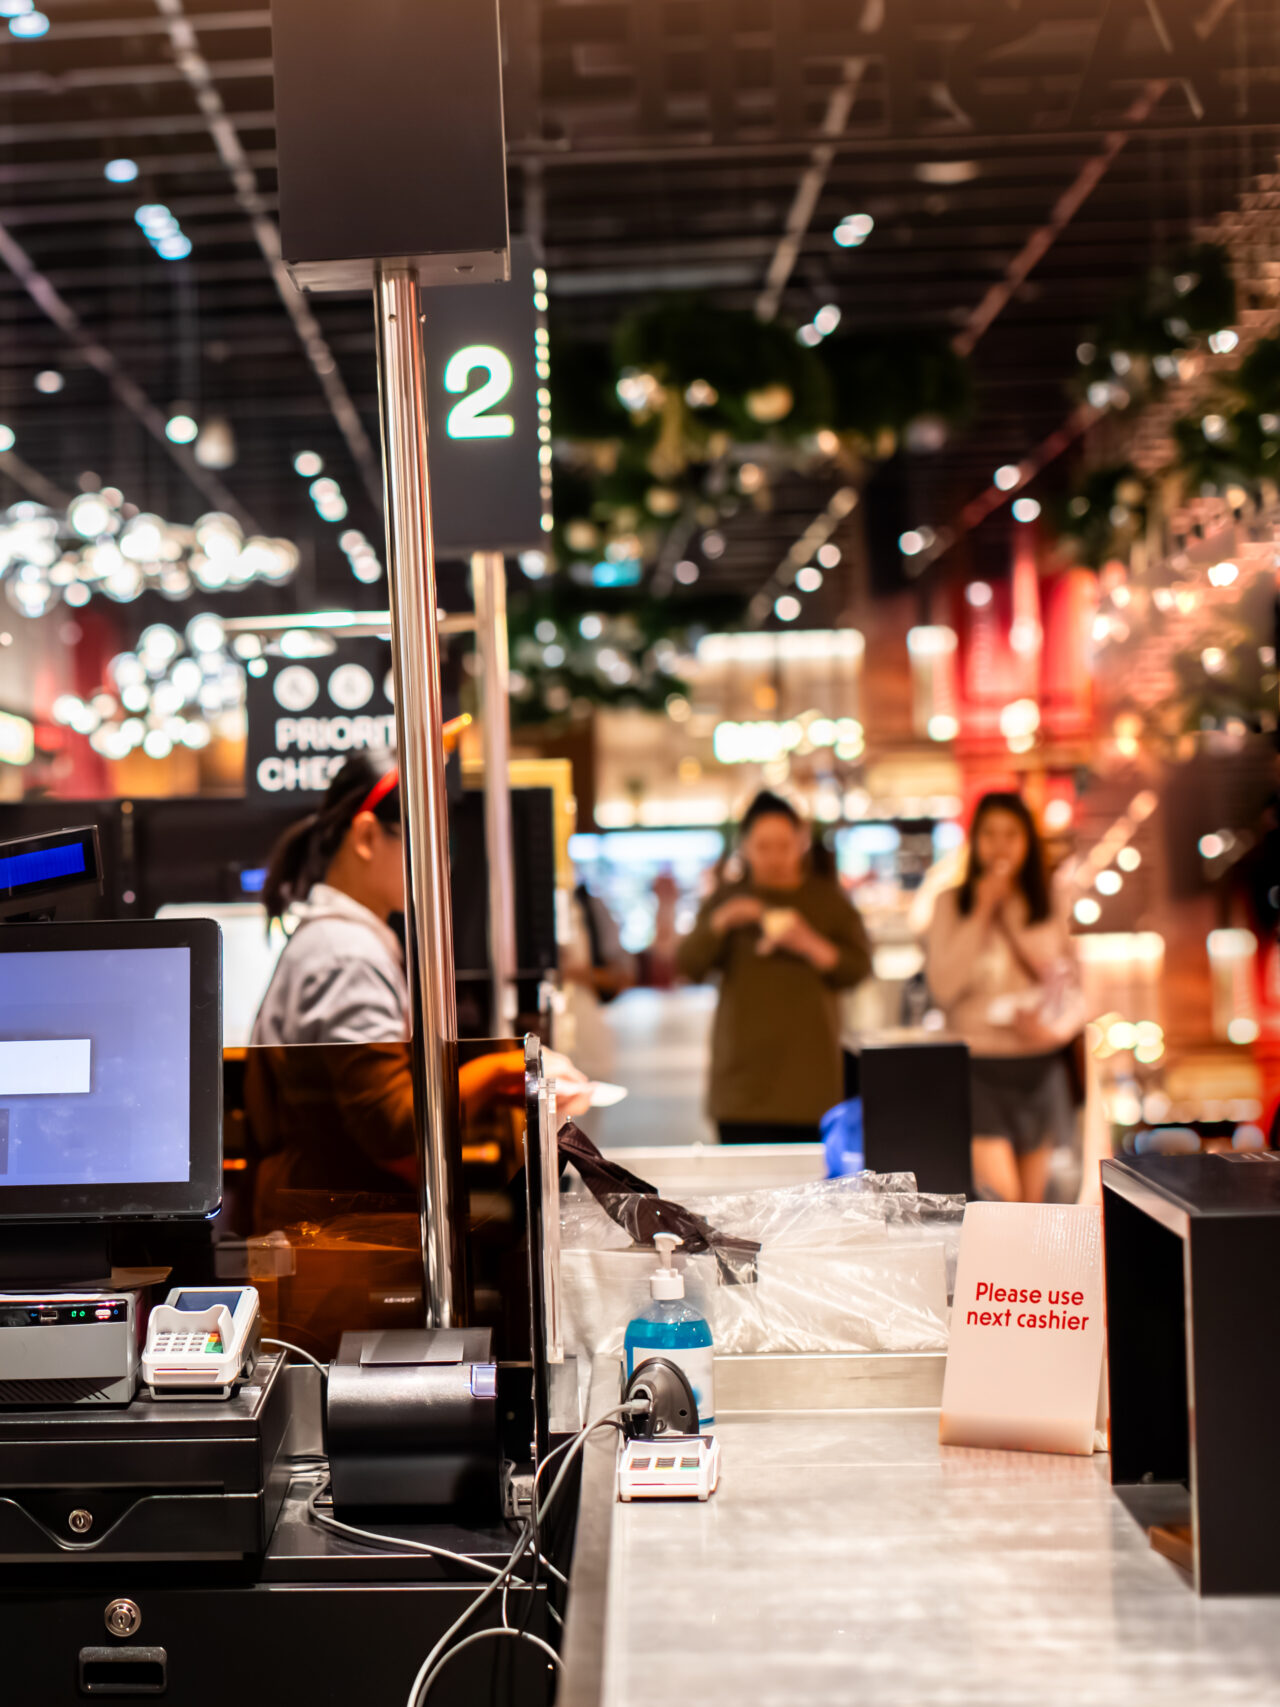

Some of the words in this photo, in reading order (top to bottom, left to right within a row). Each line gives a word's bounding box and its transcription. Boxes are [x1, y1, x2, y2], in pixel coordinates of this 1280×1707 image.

[443, 344, 515, 439] 2
[274, 715, 397, 752] PRIORIT
[975, 1281, 1042, 1304] Please
[1047, 1290, 1085, 1306] use
[966, 1308, 1012, 1327] next
[1016, 1309, 1090, 1331] cashier
